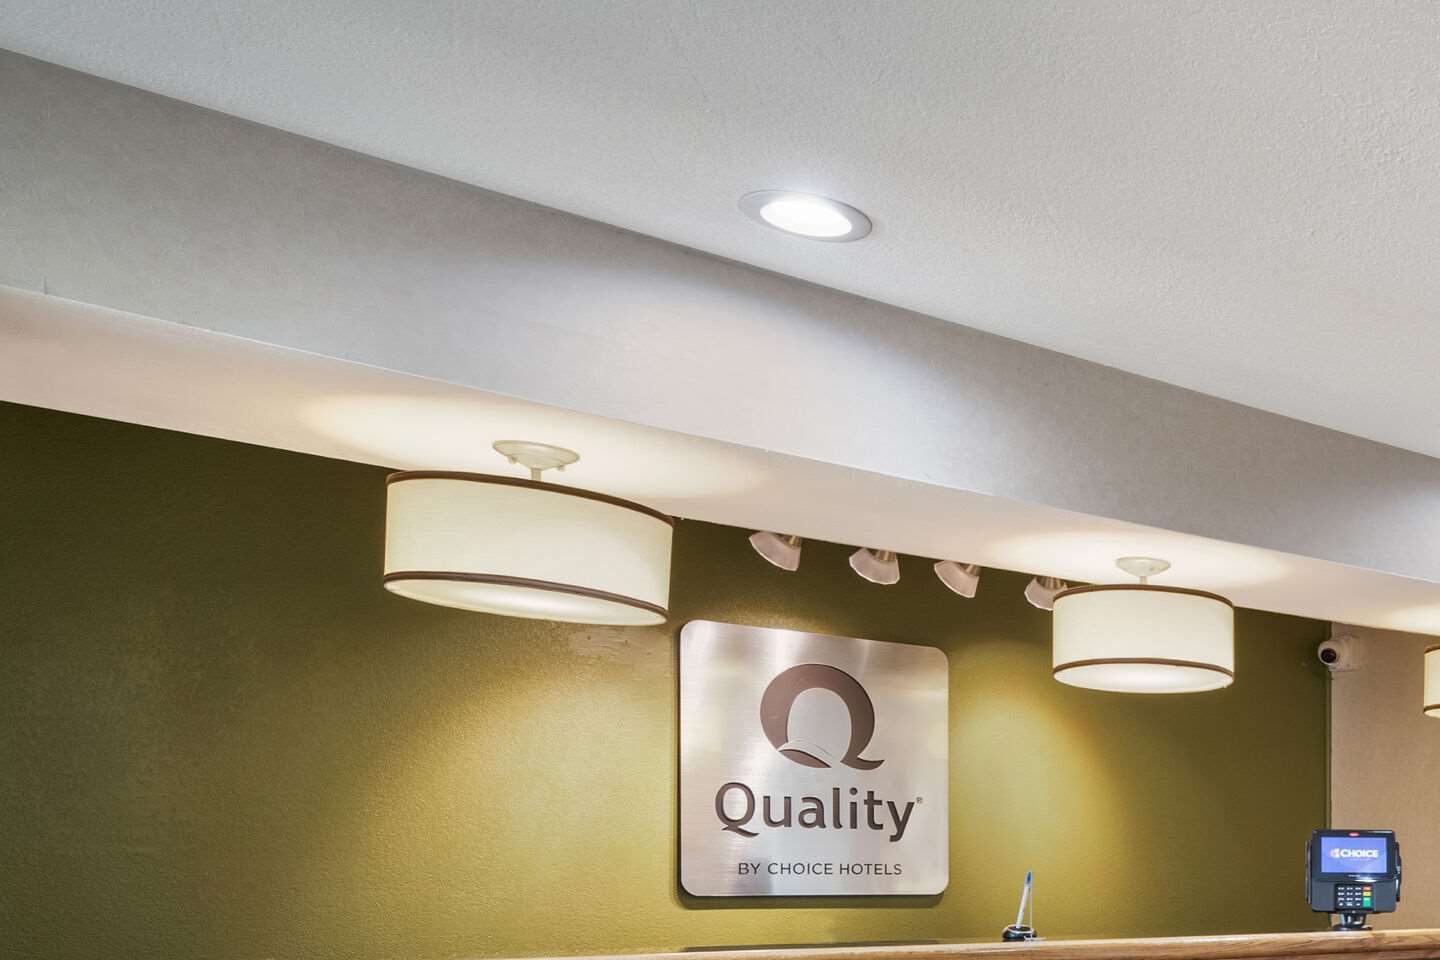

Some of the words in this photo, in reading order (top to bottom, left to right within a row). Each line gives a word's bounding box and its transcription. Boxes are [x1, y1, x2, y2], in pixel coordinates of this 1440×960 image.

[715, 782, 915, 842] Quality
[1340, 848, 1379, 858] CHOICE
[738, 862, 761, 875] BY
[767, 862, 833, 876] CHOICE
[839, 863, 902, 876] HOTELS
